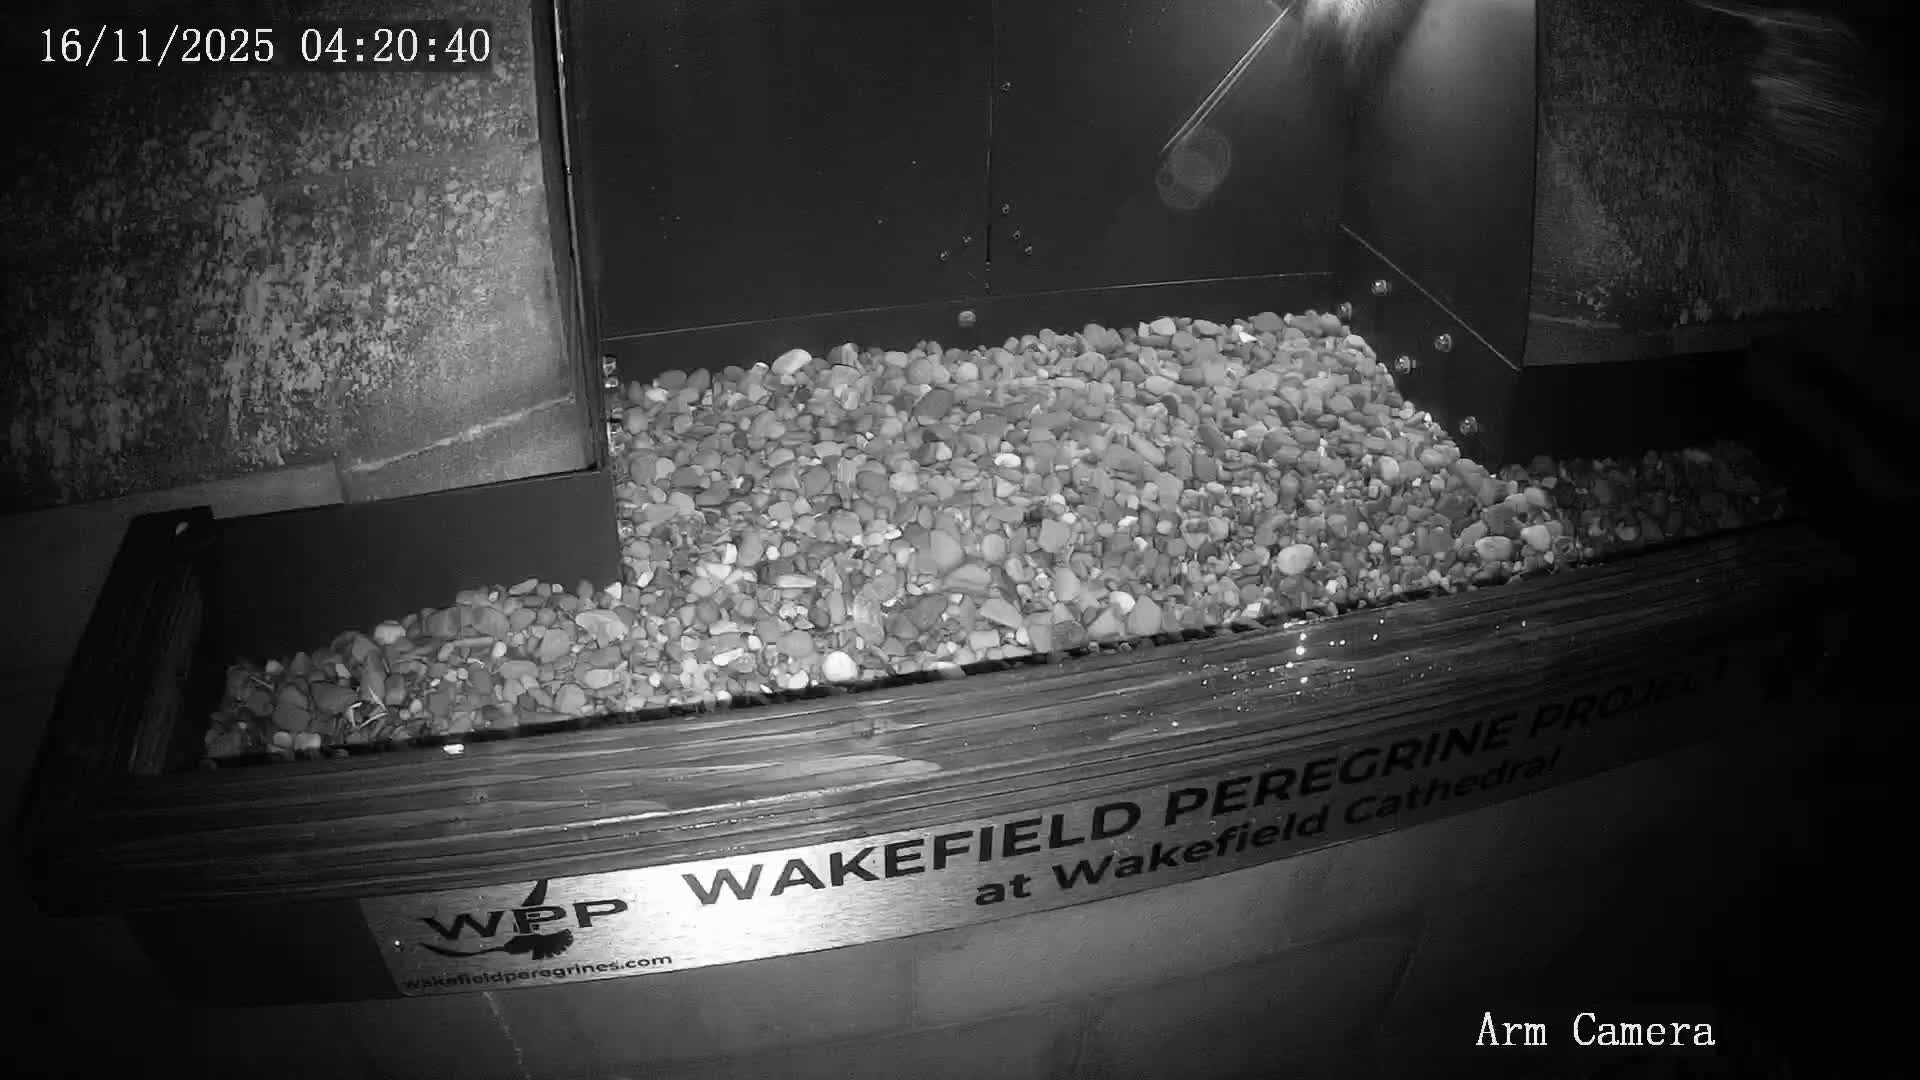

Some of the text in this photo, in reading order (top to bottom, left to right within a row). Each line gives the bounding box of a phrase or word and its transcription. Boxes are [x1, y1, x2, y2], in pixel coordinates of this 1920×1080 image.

[682, 801, 1141, 905] WAKEFIELD
[1164, 712, 1518, 826] PEREGRINE
[975, 747, 1561, 905] at Wakefield Cathedral
[420, 898, 629, 940] WPP
[401, 954, 673, 989] wakefieldperegrines.com
